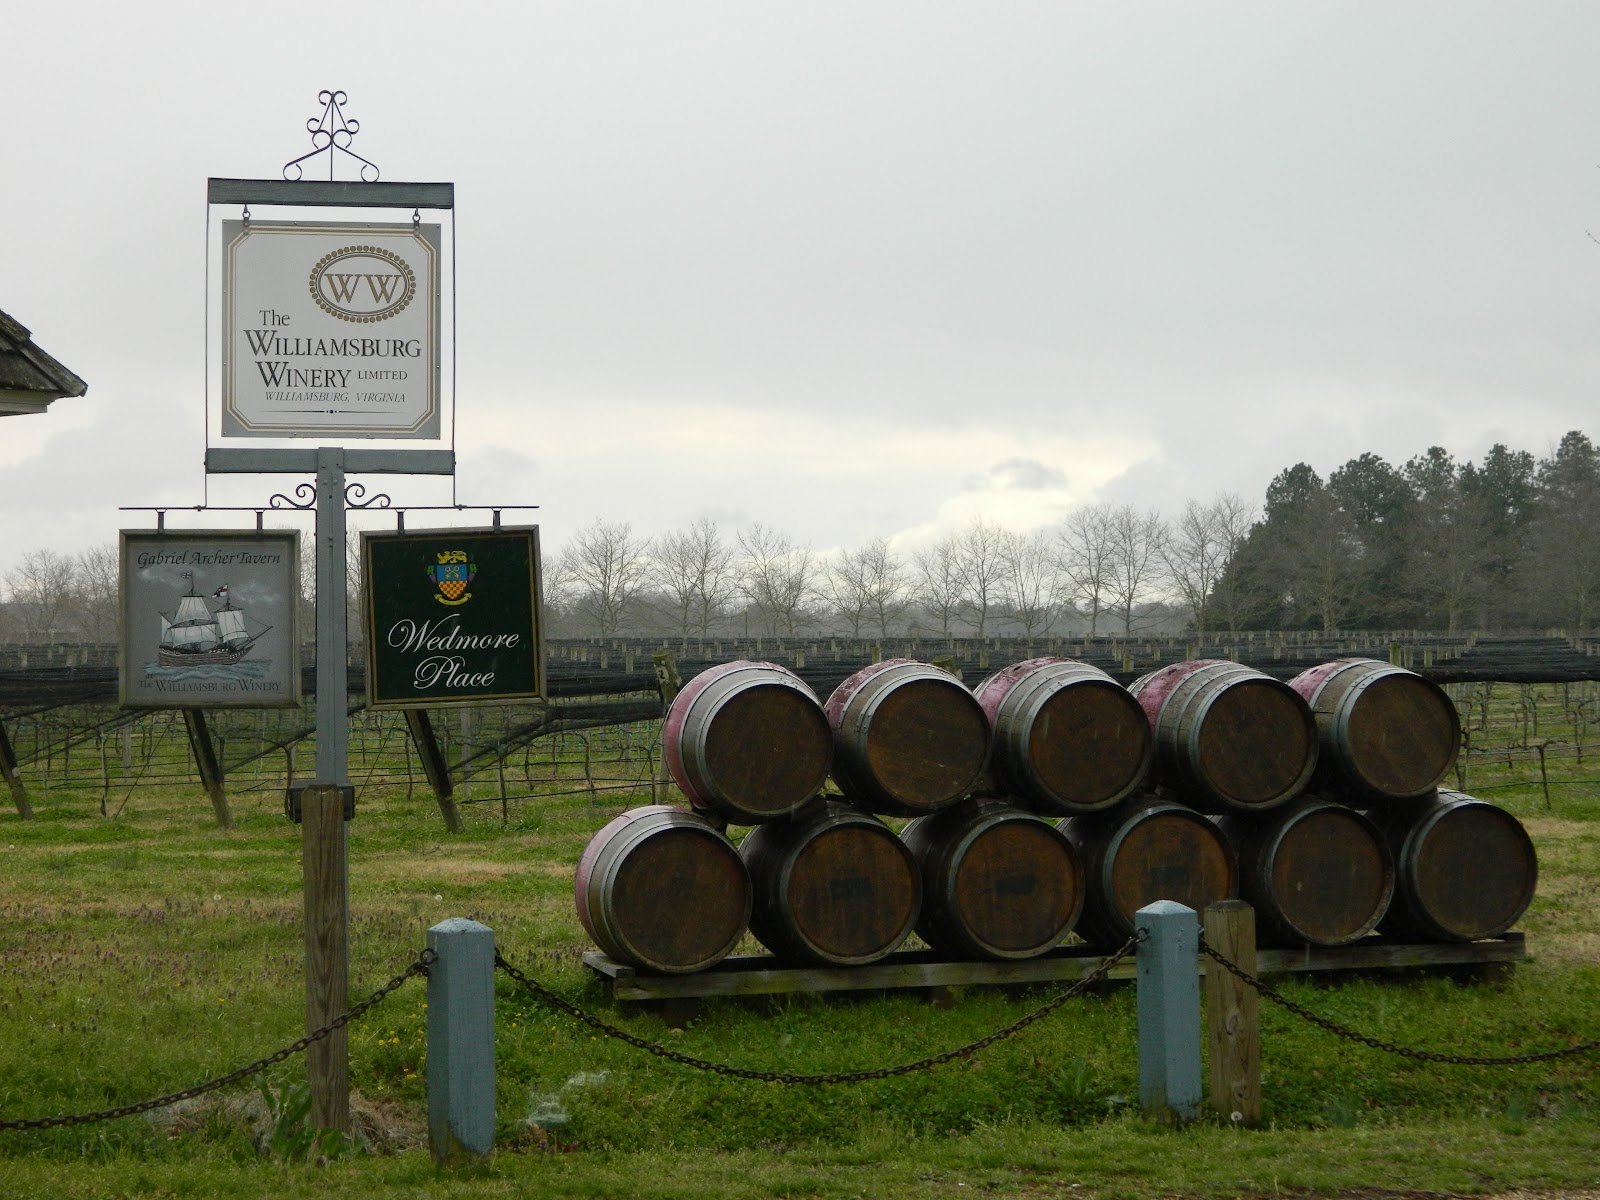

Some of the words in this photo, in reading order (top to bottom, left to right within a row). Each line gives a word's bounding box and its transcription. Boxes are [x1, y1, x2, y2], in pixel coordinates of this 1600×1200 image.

[324, 273, 403, 304] WW
[259, 309, 290, 326] The
[243, 330, 422, 357] WILLIAMSBURG
[254, 361, 352, 388] WINERY
[357, 370, 408, 380] LIMITED
[265, 391, 350, 403] WILLIAMSBURG,
[356, 392, 406, 403] VIRGINIA
[137, 549, 187, 568] Gabriel
[189, 550, 236, 565] Archer
[234, 552, 281, 564] Tavern
[388, 613, 520, 654] Wedmore
[139, 680, 153, 688] The
[155, 679, 237, 692] WILLIAMSBURG
[237, 678, 282, 691] WINERY
[413, 655, 496, 690] Place
